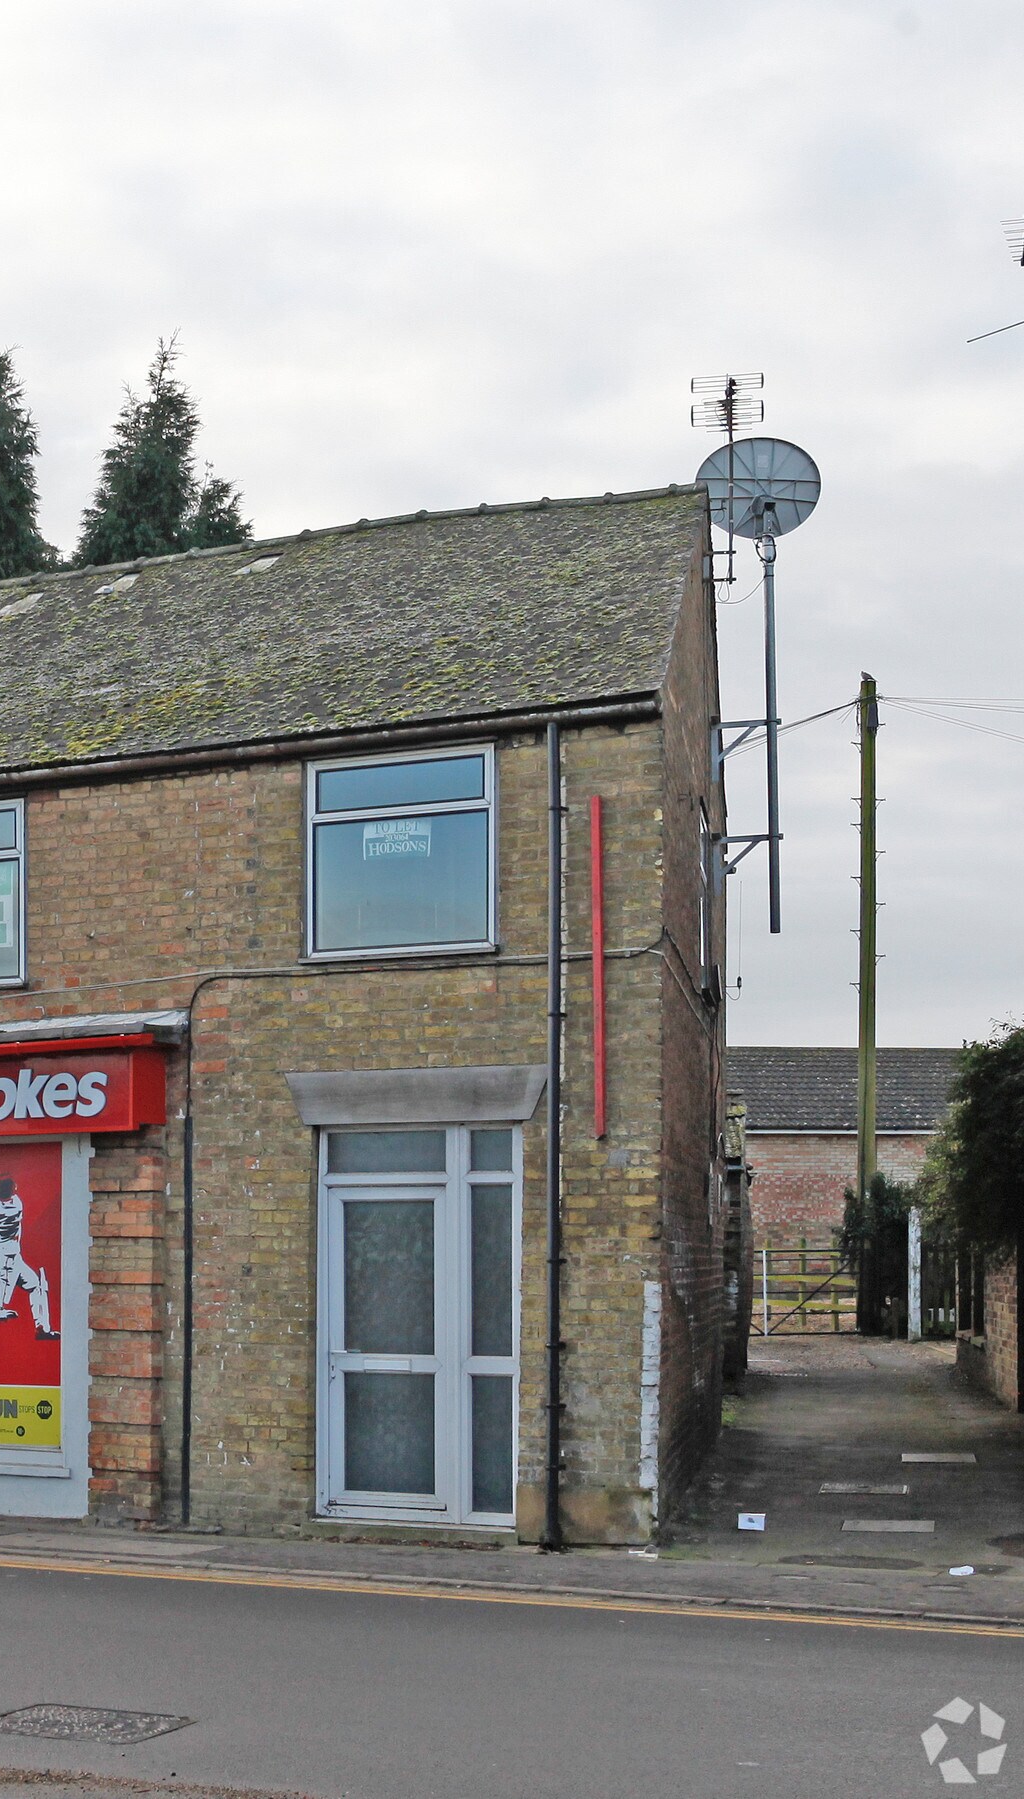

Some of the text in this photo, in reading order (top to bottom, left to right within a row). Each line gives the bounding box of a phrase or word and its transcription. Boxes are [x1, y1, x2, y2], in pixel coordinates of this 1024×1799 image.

[368, 840, 426, 857] HODSONS
[19, 1405, 35, 1413] STOPS
[37, 1405, 51, 1414] STOP
